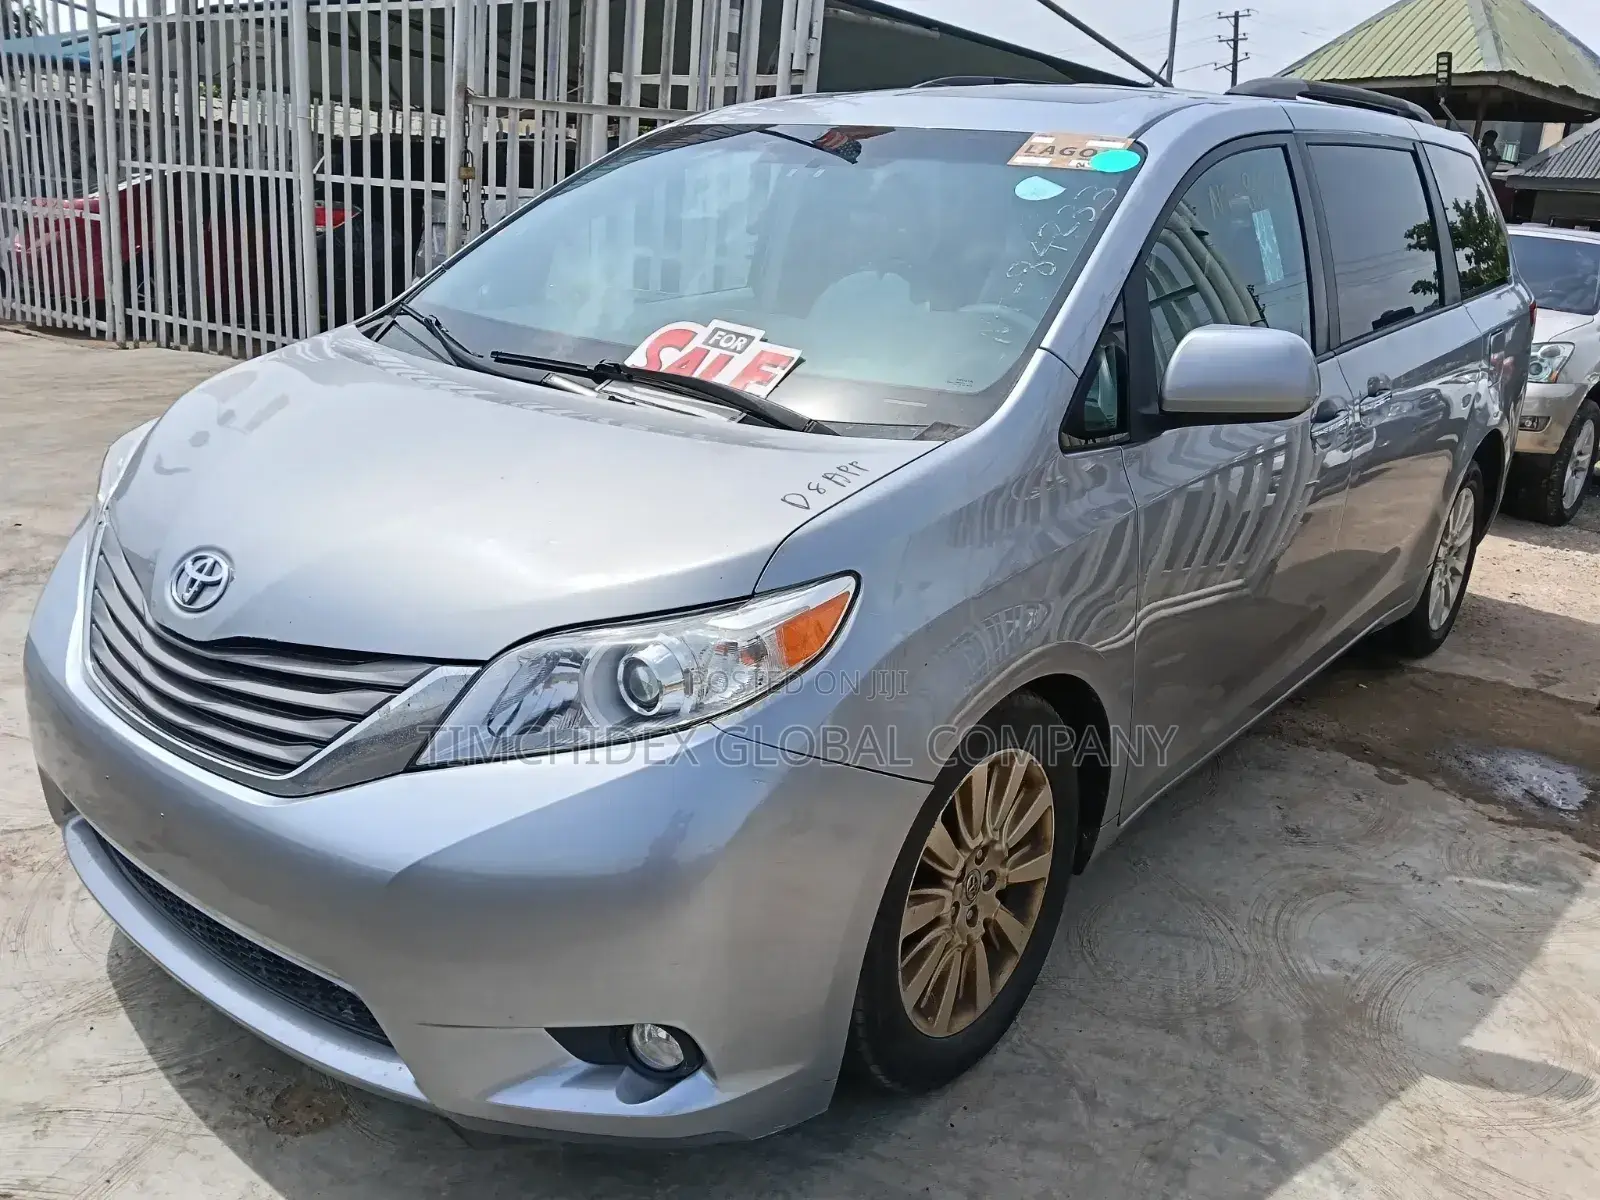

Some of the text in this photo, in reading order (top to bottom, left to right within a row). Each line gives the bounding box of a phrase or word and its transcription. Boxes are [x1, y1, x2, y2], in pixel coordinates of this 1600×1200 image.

[1023, 143, 1099, 158] LAGO
[709, 330, 748, 352] FOR
[631, 328, 794, 392] SALE
